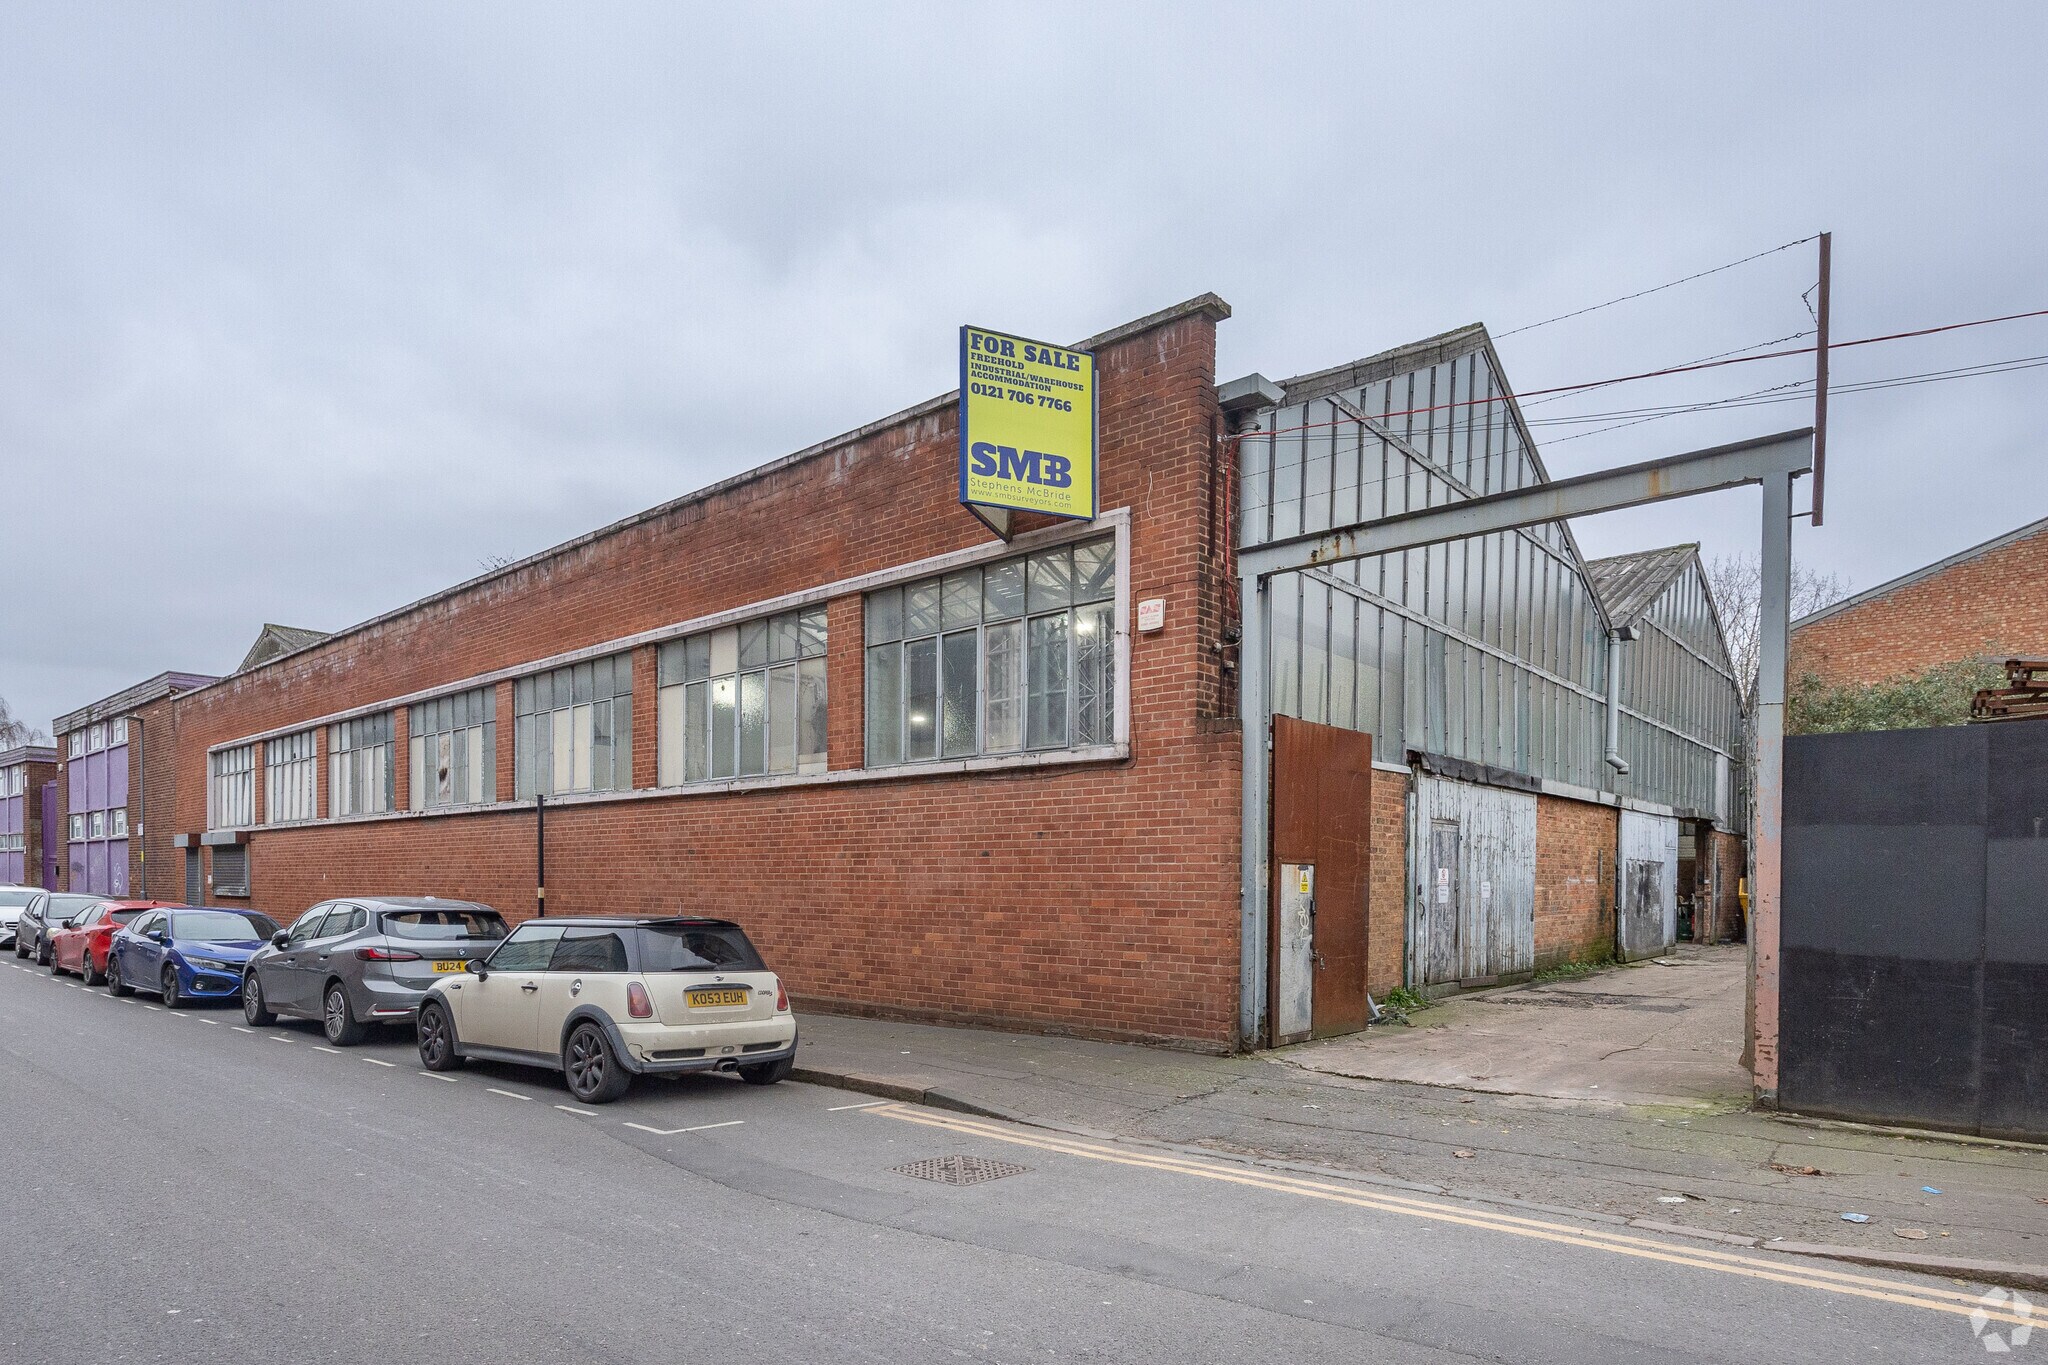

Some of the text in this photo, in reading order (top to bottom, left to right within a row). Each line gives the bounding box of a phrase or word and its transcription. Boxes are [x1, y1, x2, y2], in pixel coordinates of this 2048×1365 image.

[970, 332, 1080, 372] FOR SALE
[970, 352, 1025, 370] FREEHOLD
[970, 362, 1084, 392] INDUSTRIAL/WAREHOUSE
[970, 370, 1052, 392] ACCOMMODATION
[970, 382, 1072, 412] 0121 706 7766
[970, 441, 1072, 489] SMB
[970, 477, 1072, 501] Stephens McBride
[970, 488, 1072, 509] www.smbsurveyors.com
[436, 962, 462, 971] BU24
[692, 992, 744, 1005] KO53 EUH
